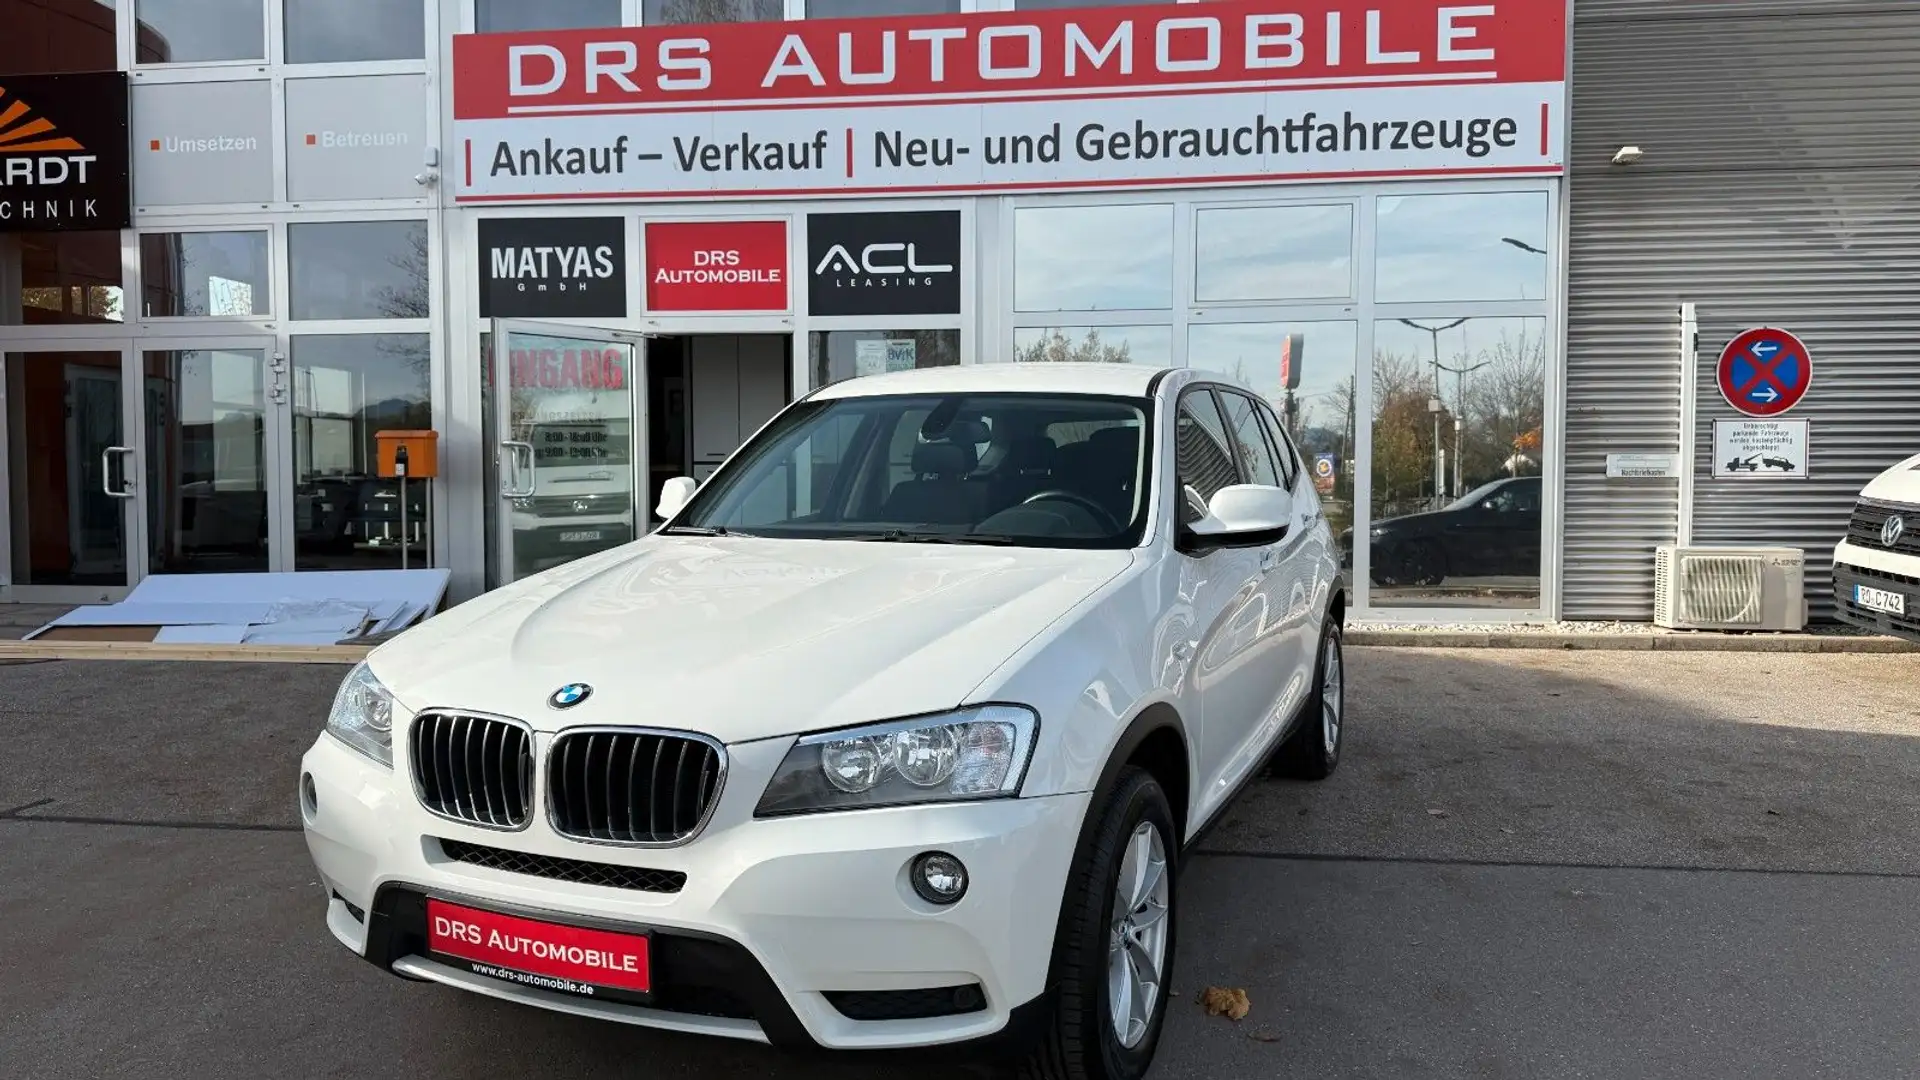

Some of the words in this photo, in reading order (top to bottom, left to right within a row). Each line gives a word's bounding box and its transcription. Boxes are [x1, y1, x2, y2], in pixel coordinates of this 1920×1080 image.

[508, 37, 711, 96] DRS
[760, 5, 1496, 88] AUTOMOBILE
[165, 135, 257, 153] Umsetzen
[321, 130, 408, 148] Betreuen
[490, 135, 628, 177] Ankauf
[672, 130, 828, 172] Verkauf
[875, 130, 970, 168] Neu-
[984, 121, 1061, 165] und
[1075, 111, 1517, 162] Gebrauchtfahrzeuge
[0, 155, 97, 186] RDT
[491, 245, 614, 279] MATYAS
[693, 249, 741, 267] DRS
[815, 242, 953, 275] ACL
[836, 277, 932, 288] LEASING
[435, 916, 482, 945] DRS
[472, 962, 595, 996] www.drs-automobile.de
